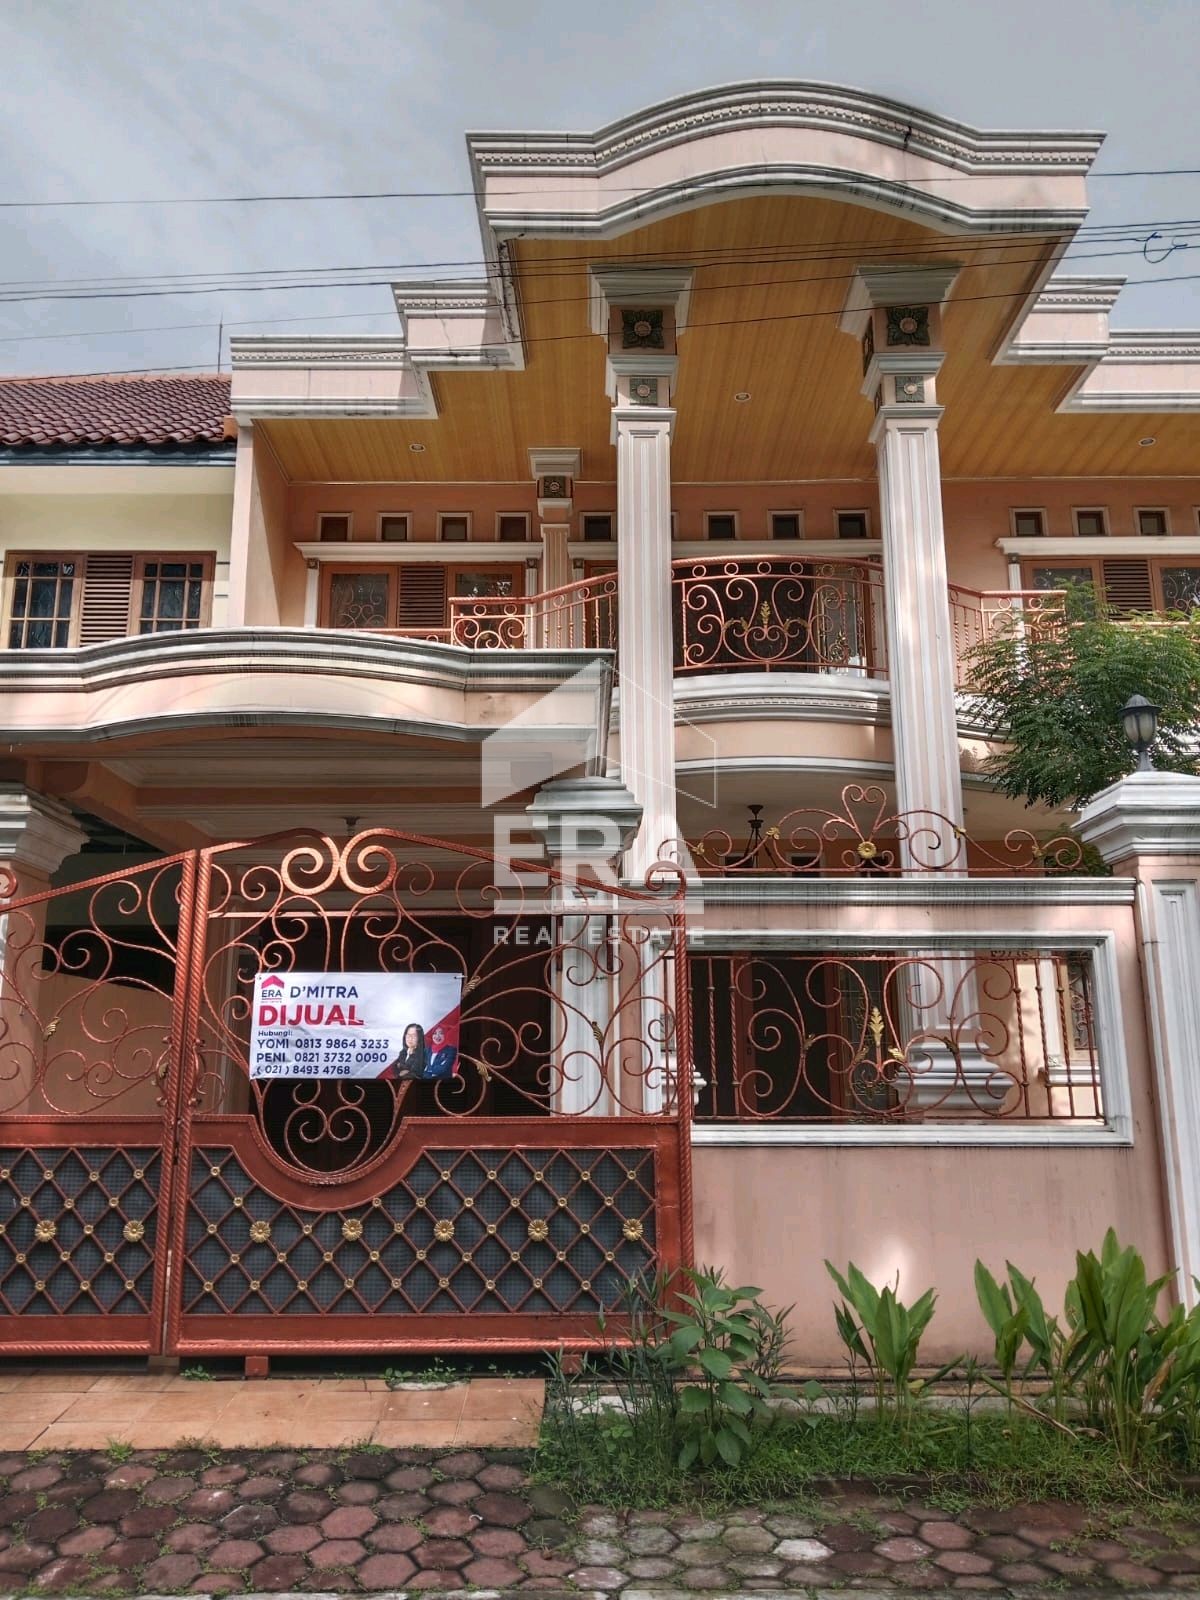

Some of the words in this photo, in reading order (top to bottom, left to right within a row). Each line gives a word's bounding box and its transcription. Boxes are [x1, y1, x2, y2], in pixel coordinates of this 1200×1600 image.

[290, 986, 359, 998] D'MITRA
[259, 1005, 364, 1026] DIJUAL
[257, 1039, 288, 1048] YOMI
[295, 1039, 322, 1048] 0813
[326, 1039, 357, 1048] 9864
[361, 1039, 389, 1049] 3233
[295, 1053, 319, 1062] 0821
[324, 1053, 351, 1062] 3732
[356, 1053, 387, 1062] 0090
[293, 1065, 319, 1074] 8493
[323, 1066, 350, 1074] 4768
